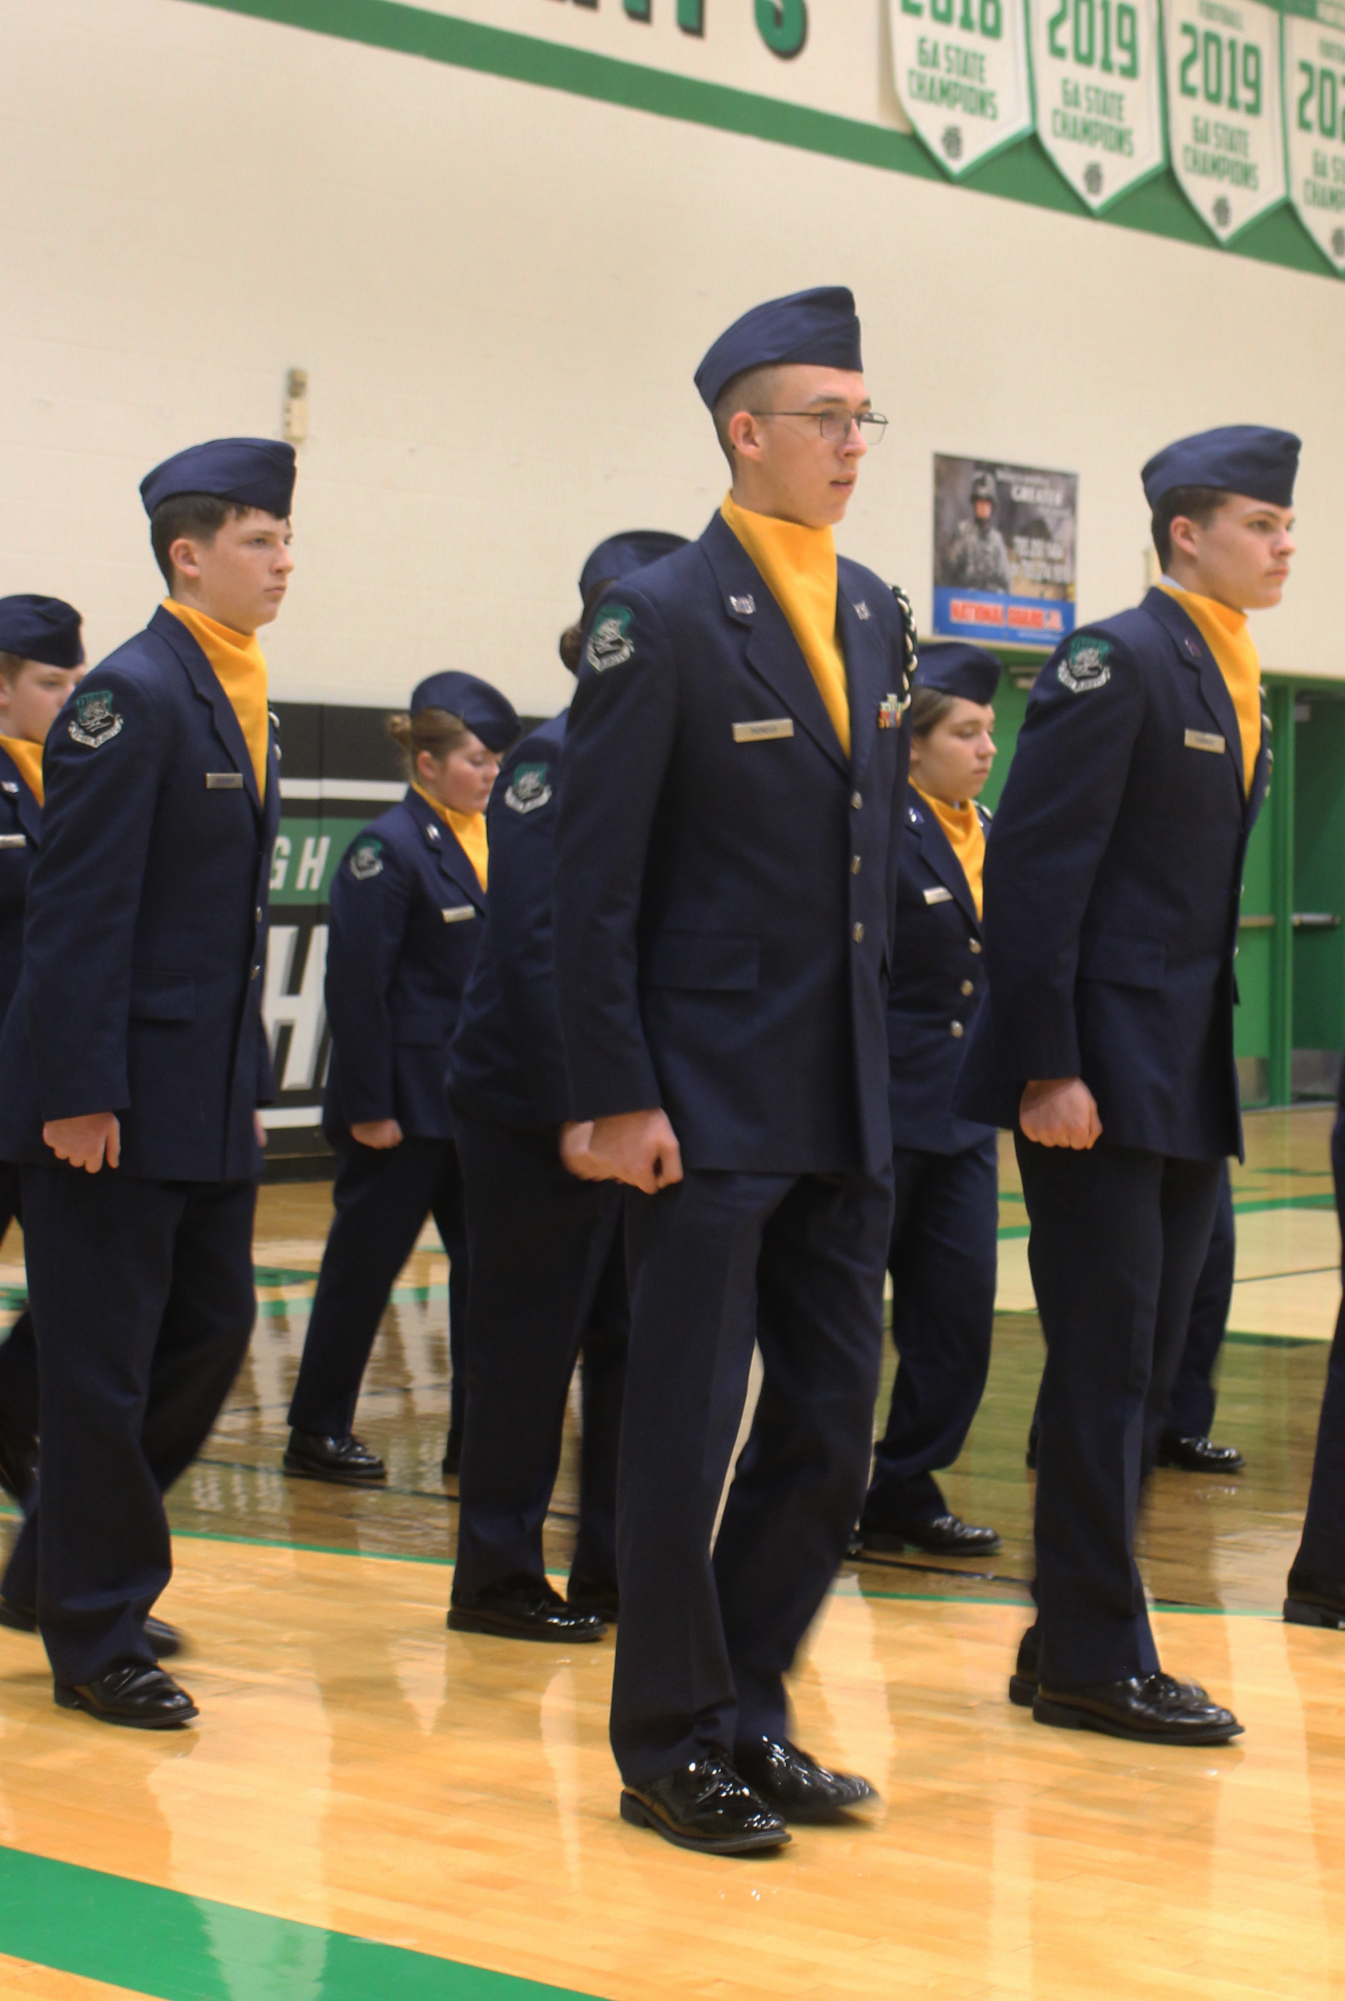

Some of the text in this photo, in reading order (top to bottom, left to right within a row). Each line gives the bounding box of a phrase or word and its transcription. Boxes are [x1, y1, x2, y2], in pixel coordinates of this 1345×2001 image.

[944, 43, 985, 83] STATE
[1048, 0, 1138, 80] 2019
[1180, 20, 1261, 117] 2019
[908, 68, 998, 120] CHAMPIONS
[1085, 84, 1124, 122] STATE
[1053, 107, 1134, 158] CHAMPIONS
[1213, 120, 1249, 157] STATE
[1183, 143, 1259, 192] CHAMPIONS
